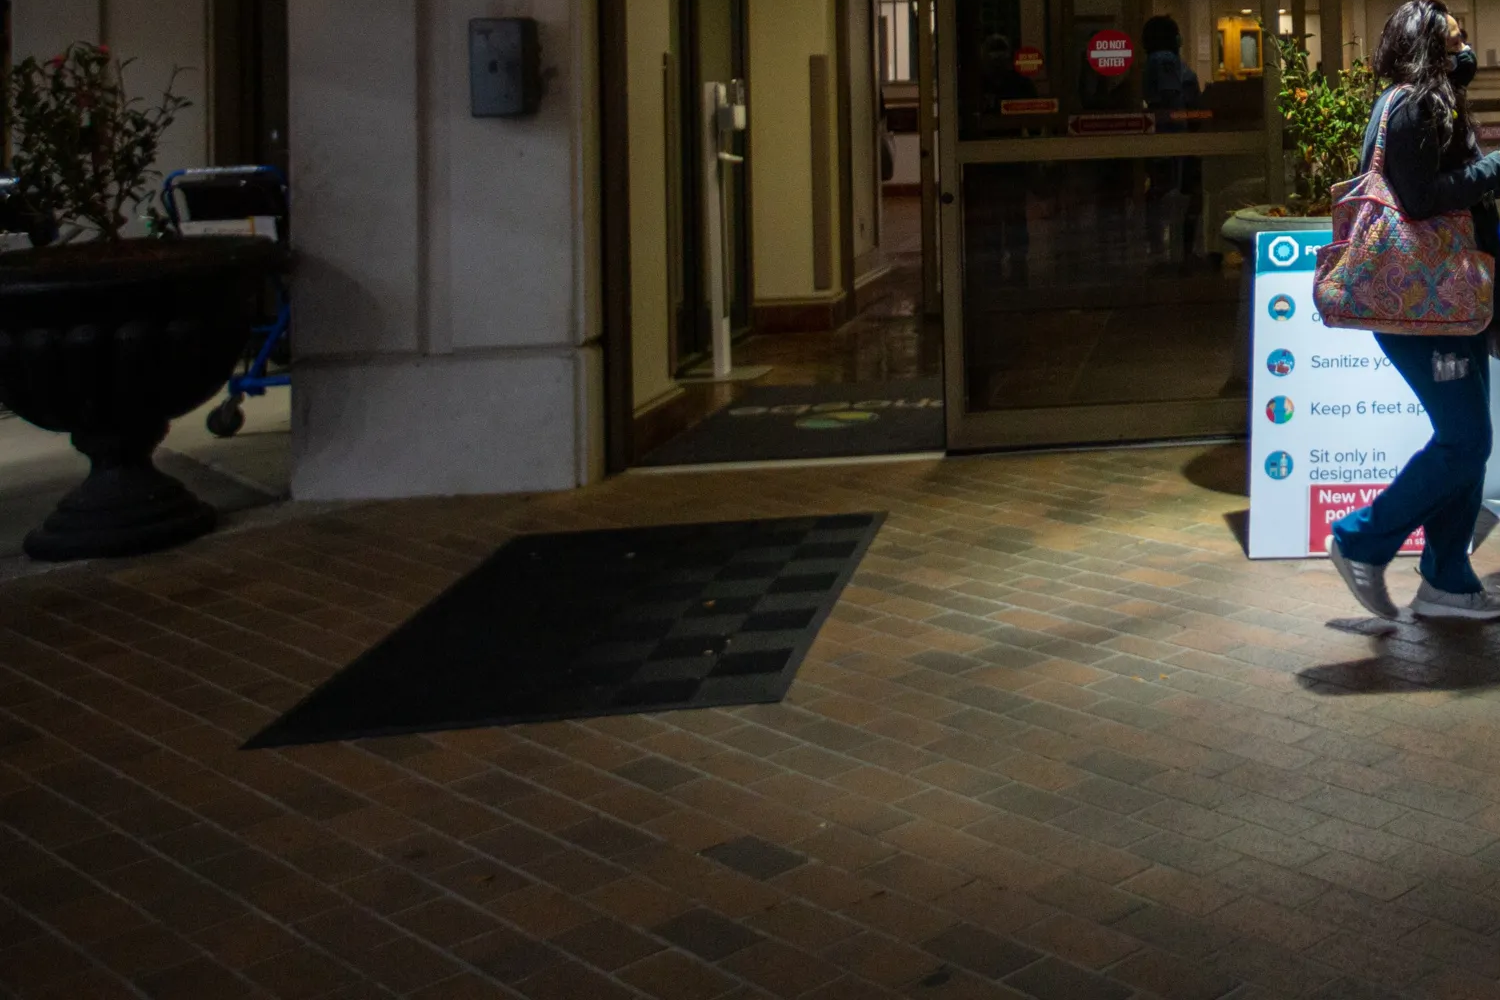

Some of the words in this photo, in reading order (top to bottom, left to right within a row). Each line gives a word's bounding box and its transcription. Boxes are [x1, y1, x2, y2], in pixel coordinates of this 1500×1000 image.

[1095, 40, 1108, 49] DO
[1109, 39, 1126, 49] NOT
[1098, 57, 1125, 68] ENTER
[1311, 354, 1370, 369] Sanitize
[1374, 357, 1391, 371] yo
[1310, 401, 1351, 418] Keep
[1356, 401, 1366, 414] 6
[1372, 400, 1402, 414] feet
[1407, 402, 1426, 417] ap
[1309, 449, 1330, 463] Sit
[1334, 449, 1368, 466] only
[1372, 449, 1386, 462] in
[1309, 466, 1398, 483] designated
[1319, 489, 1356, 504] New
